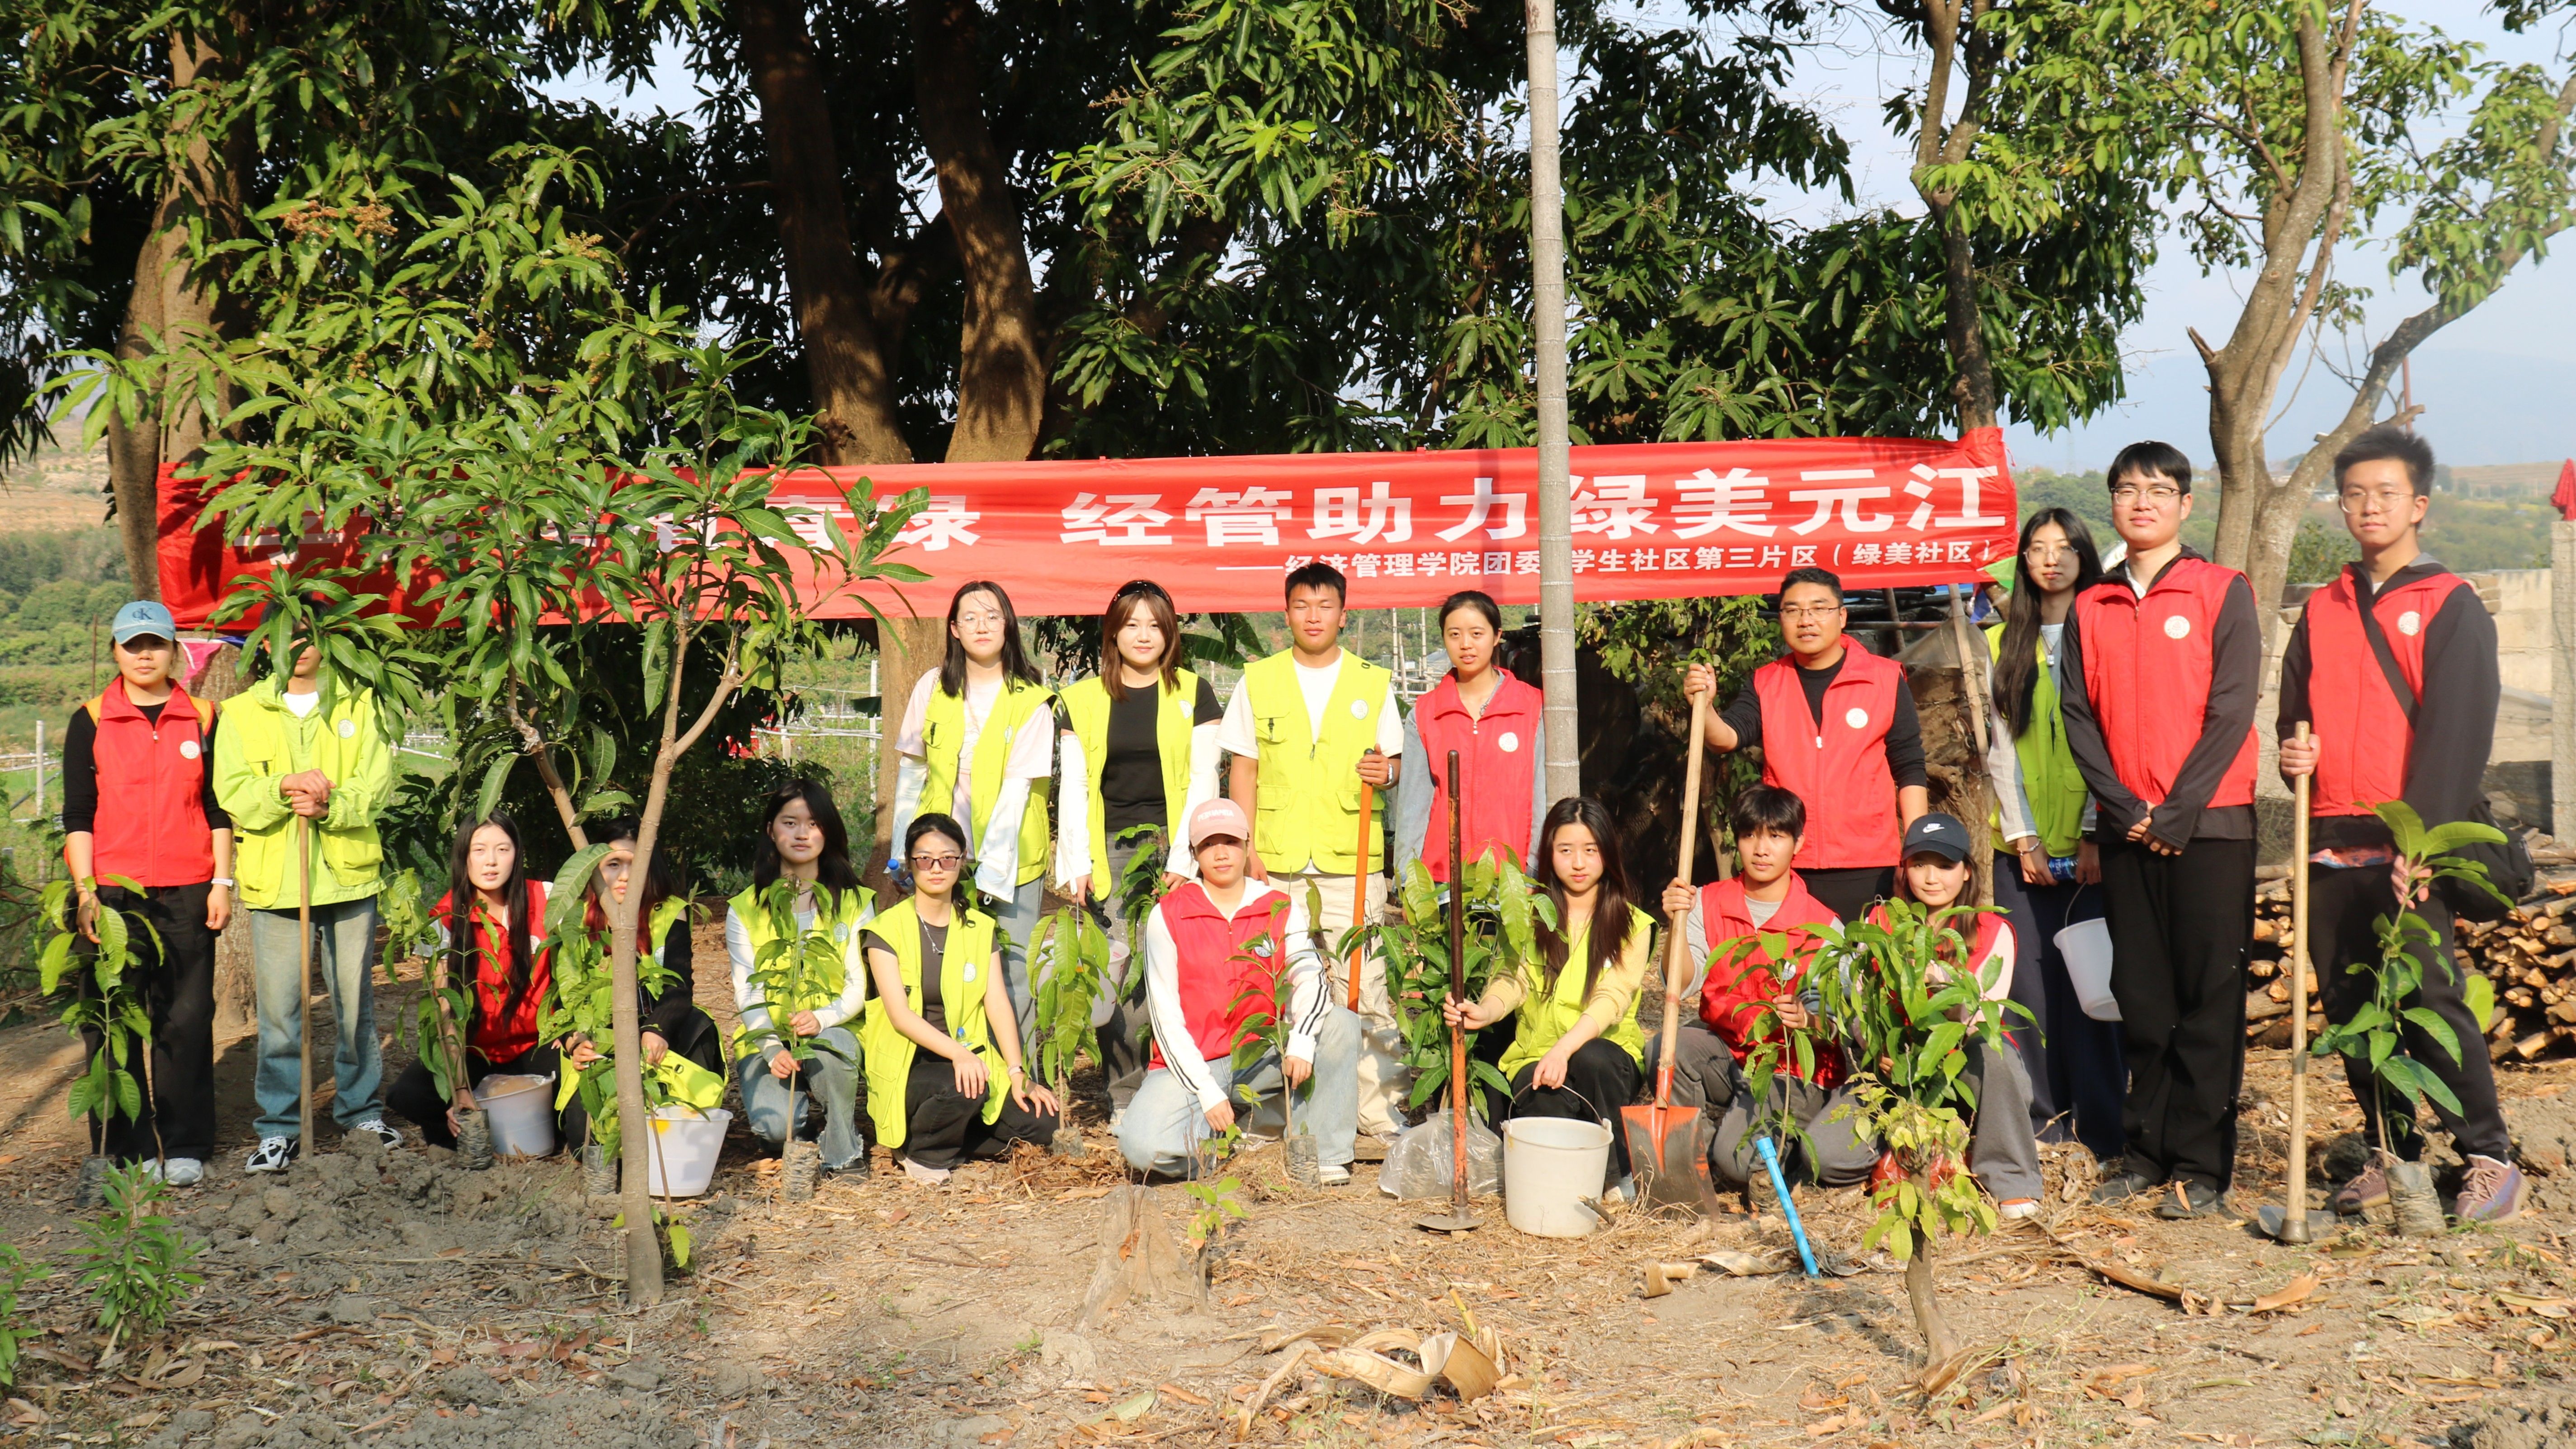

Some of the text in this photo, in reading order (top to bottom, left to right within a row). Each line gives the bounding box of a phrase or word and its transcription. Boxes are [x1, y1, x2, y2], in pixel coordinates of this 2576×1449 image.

[1060, 463, 2006, 547] 经管助力绿美元江
